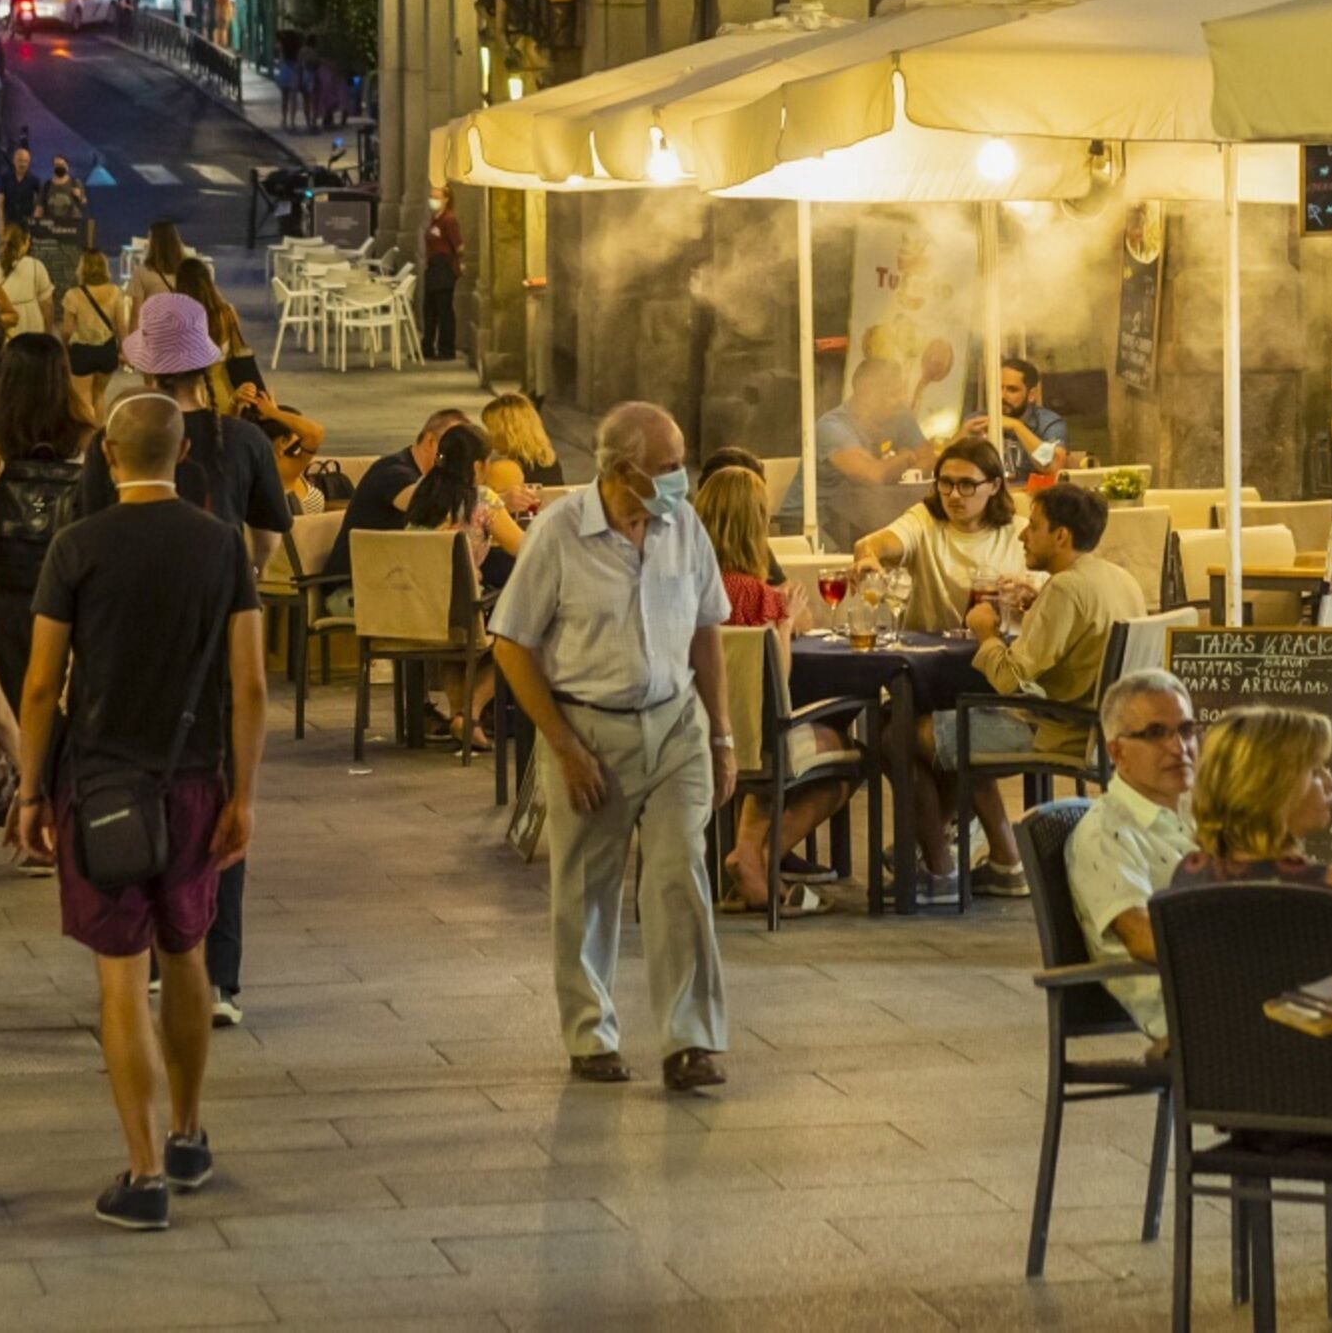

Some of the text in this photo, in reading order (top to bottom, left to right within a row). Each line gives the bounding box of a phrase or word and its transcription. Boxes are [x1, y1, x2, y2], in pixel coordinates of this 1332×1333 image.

[1195, 634, 1256, 654] TAPAS
[1180, 661, 1244, 676] PATATAS
[1240, 677, 1330, 695] ARRUGADAS
